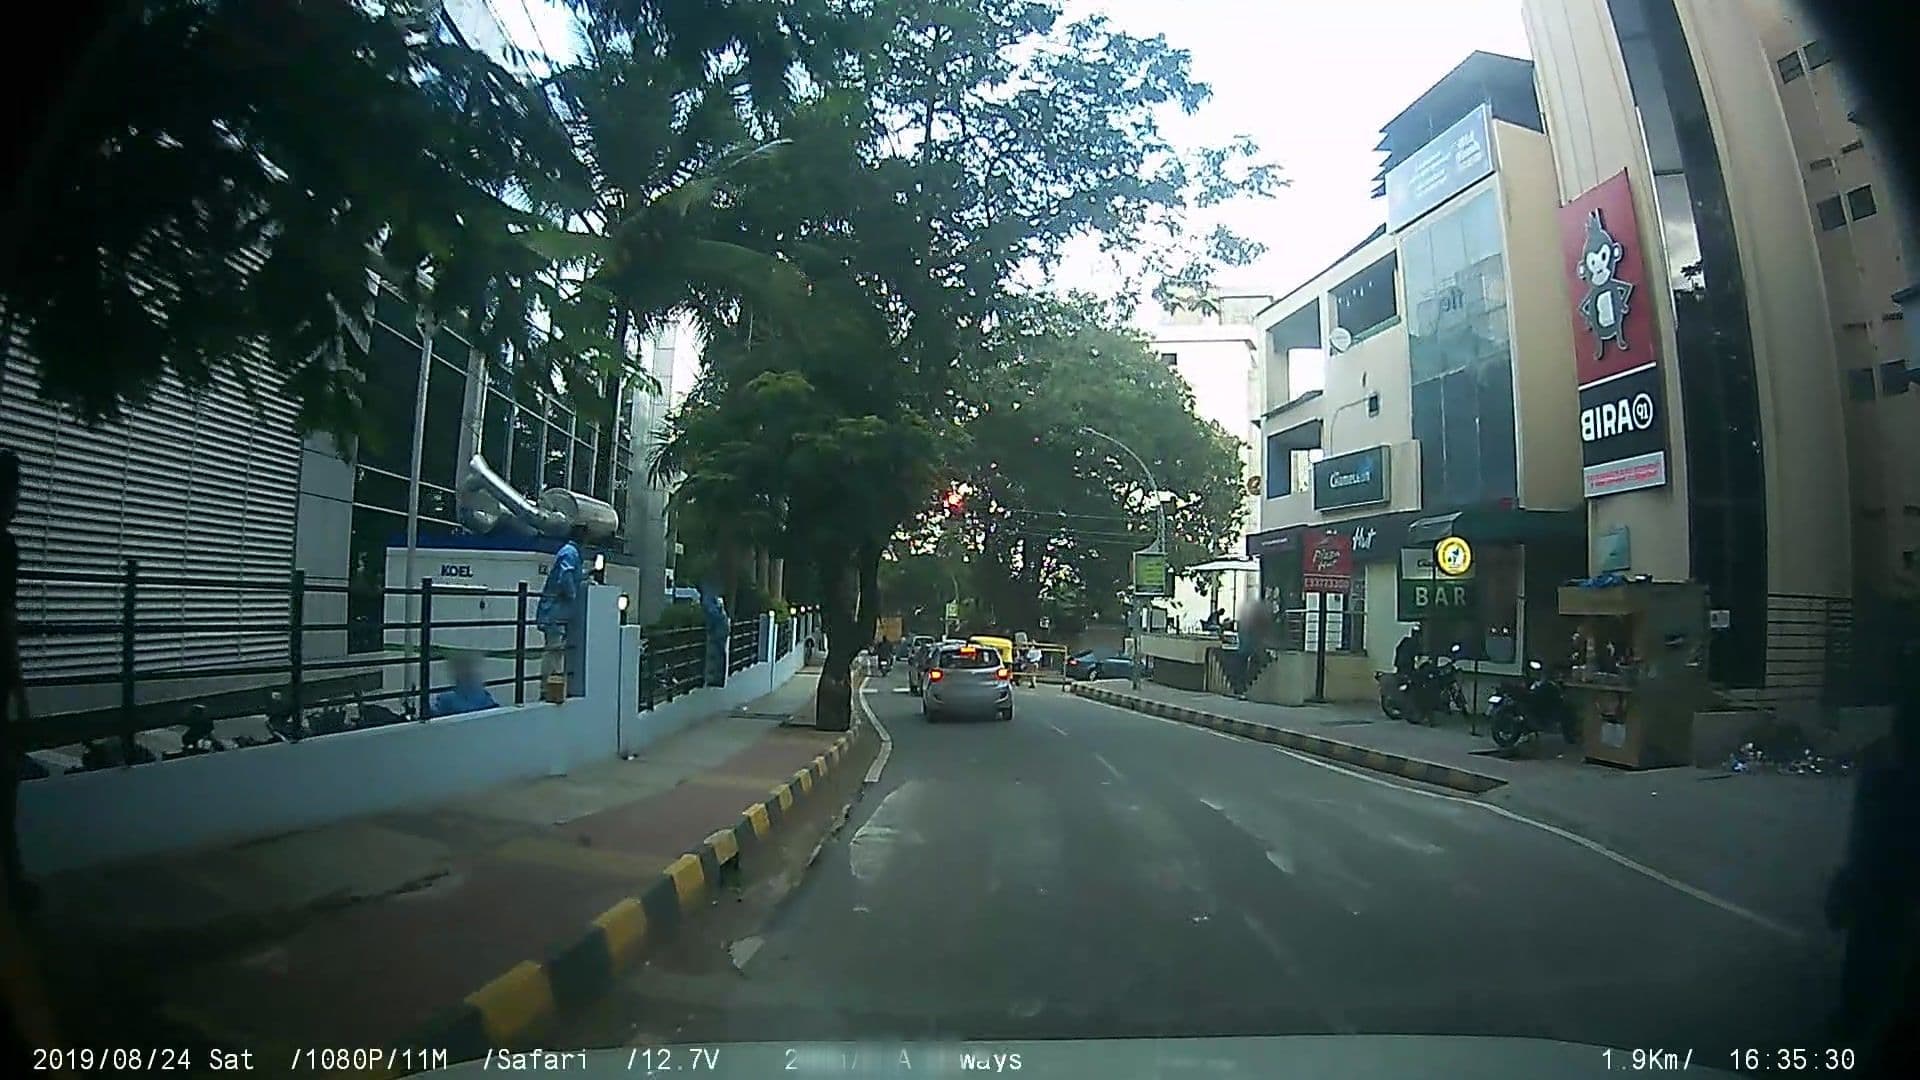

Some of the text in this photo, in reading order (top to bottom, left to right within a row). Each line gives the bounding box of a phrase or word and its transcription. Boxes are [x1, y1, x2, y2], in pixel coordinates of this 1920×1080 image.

[1581, 399, 1634, 441] BIRA
[1352, 527, 1377, 551] Hut
[441, 564, 474, 578] KOEL
[1415, 586, 1467, 607] BAR
